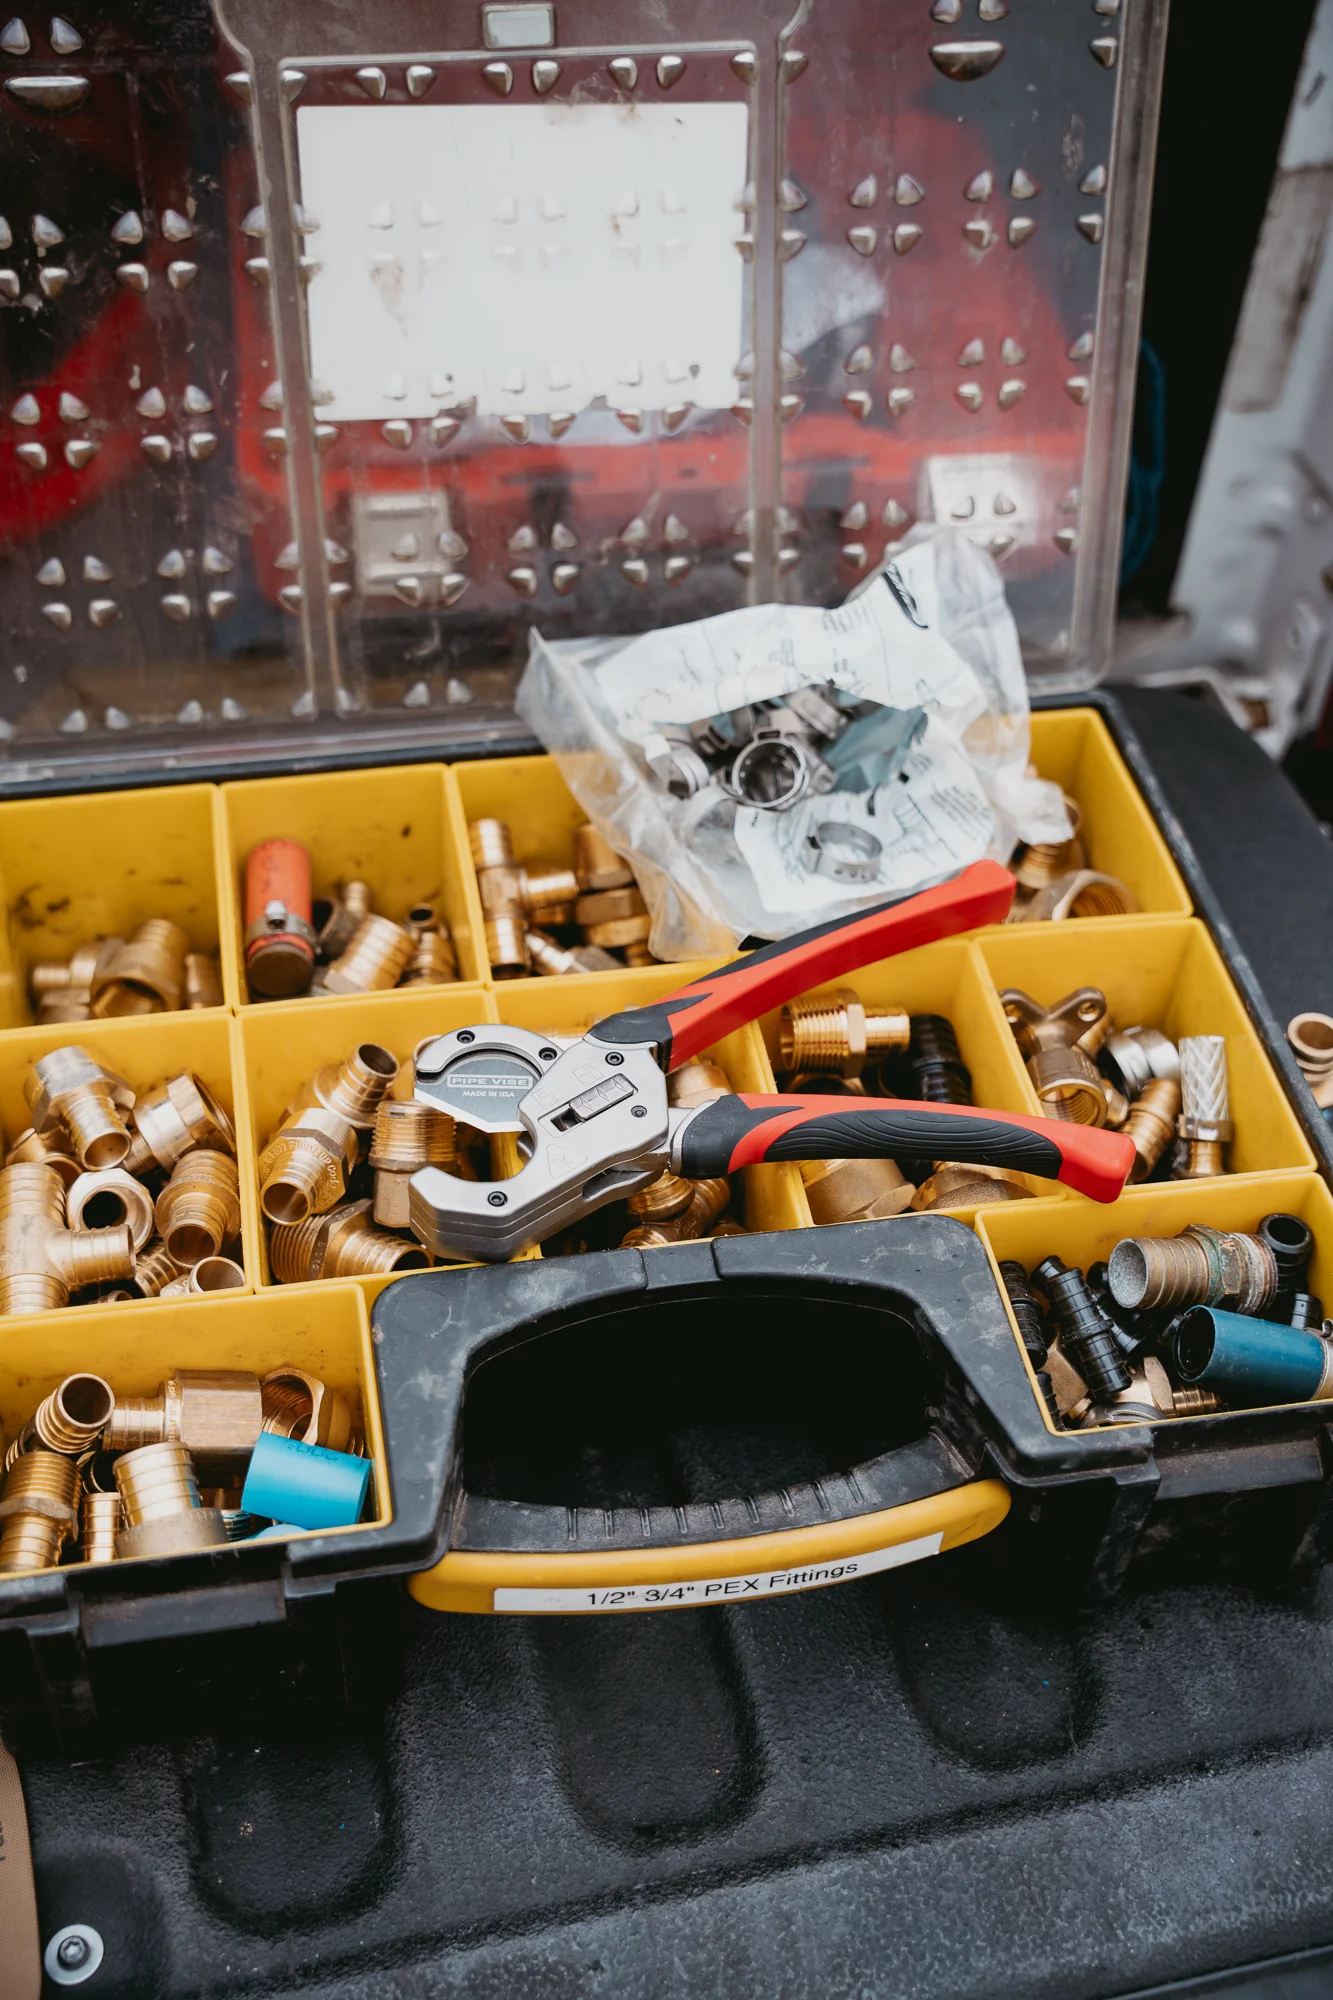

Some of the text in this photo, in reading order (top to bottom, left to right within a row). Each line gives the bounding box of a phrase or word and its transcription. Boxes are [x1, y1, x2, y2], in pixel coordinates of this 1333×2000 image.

[451, 1077, 528, 1086] PIPE VISE
[587, 1563, 859, 1605] 1/2" 3/4" PEX Fittings
